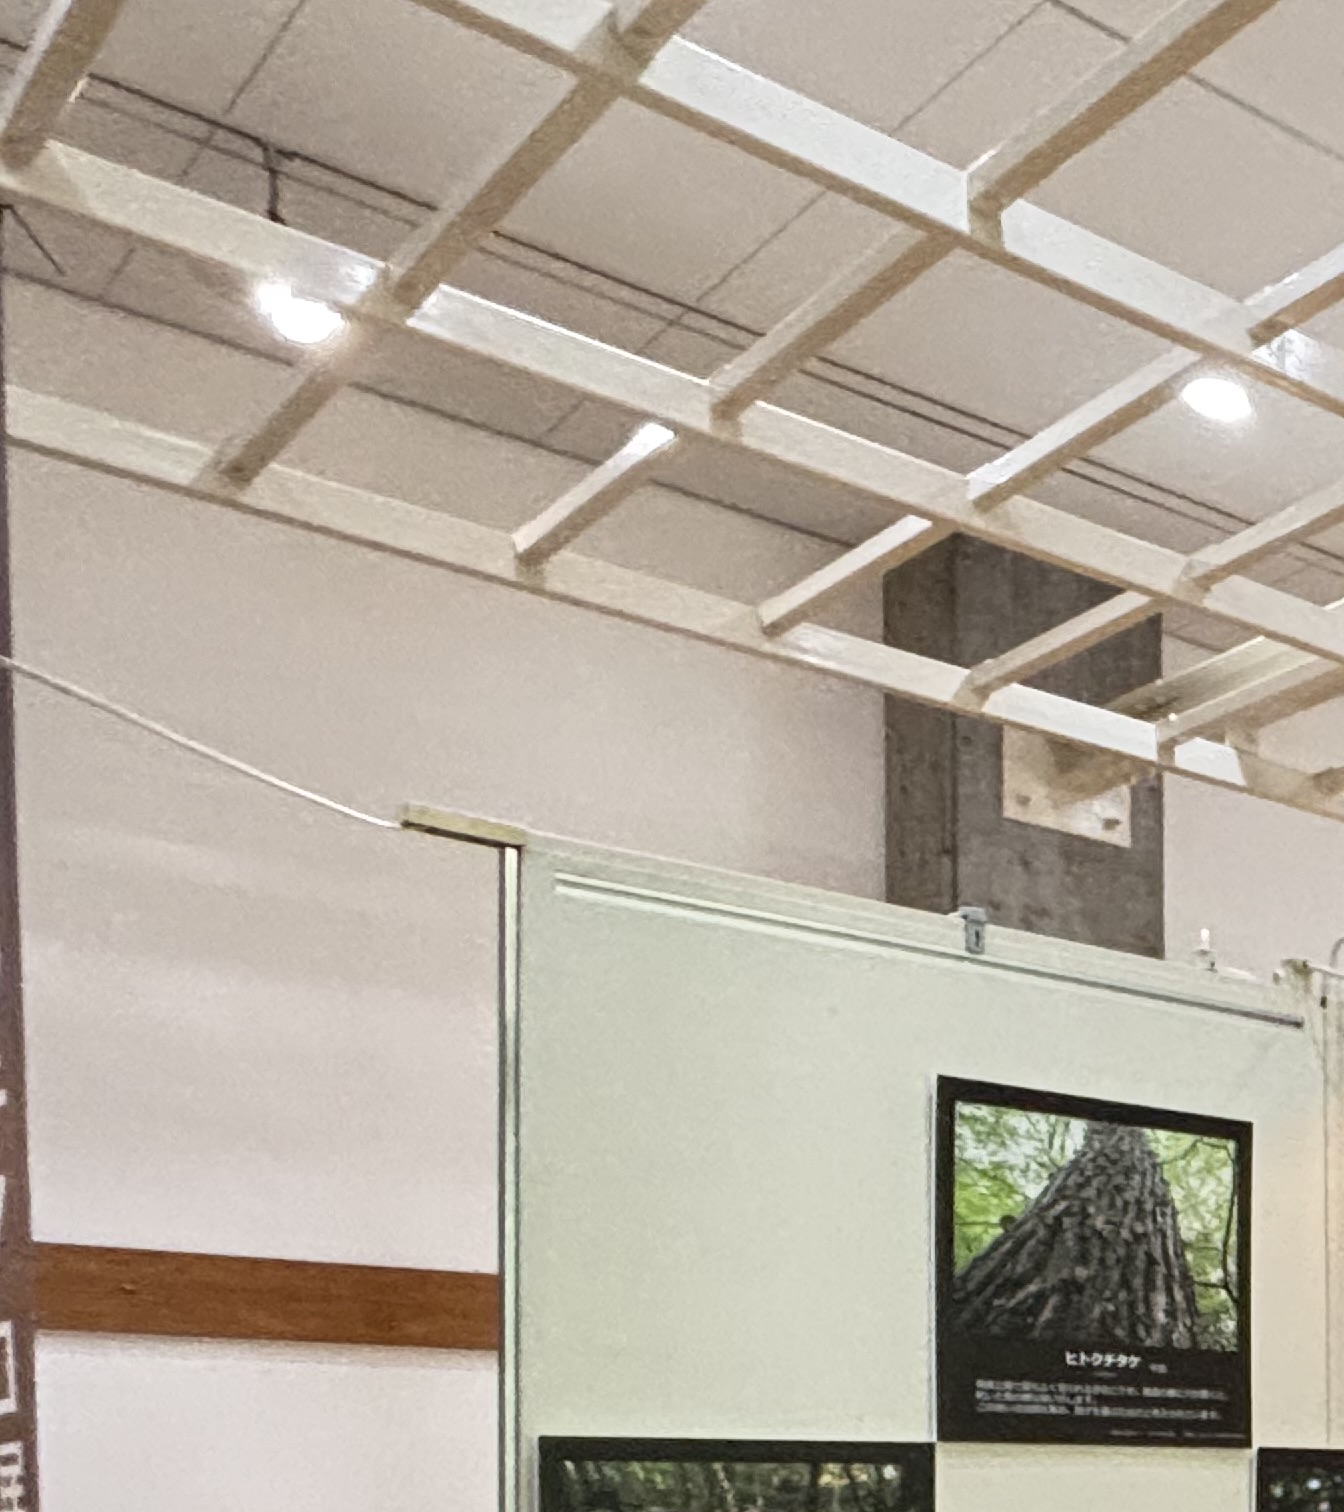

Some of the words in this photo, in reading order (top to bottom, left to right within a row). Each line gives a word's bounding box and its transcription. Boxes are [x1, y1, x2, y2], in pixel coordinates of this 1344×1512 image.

[1065, 1351, 1142, 1368] ヒトクチタケ
